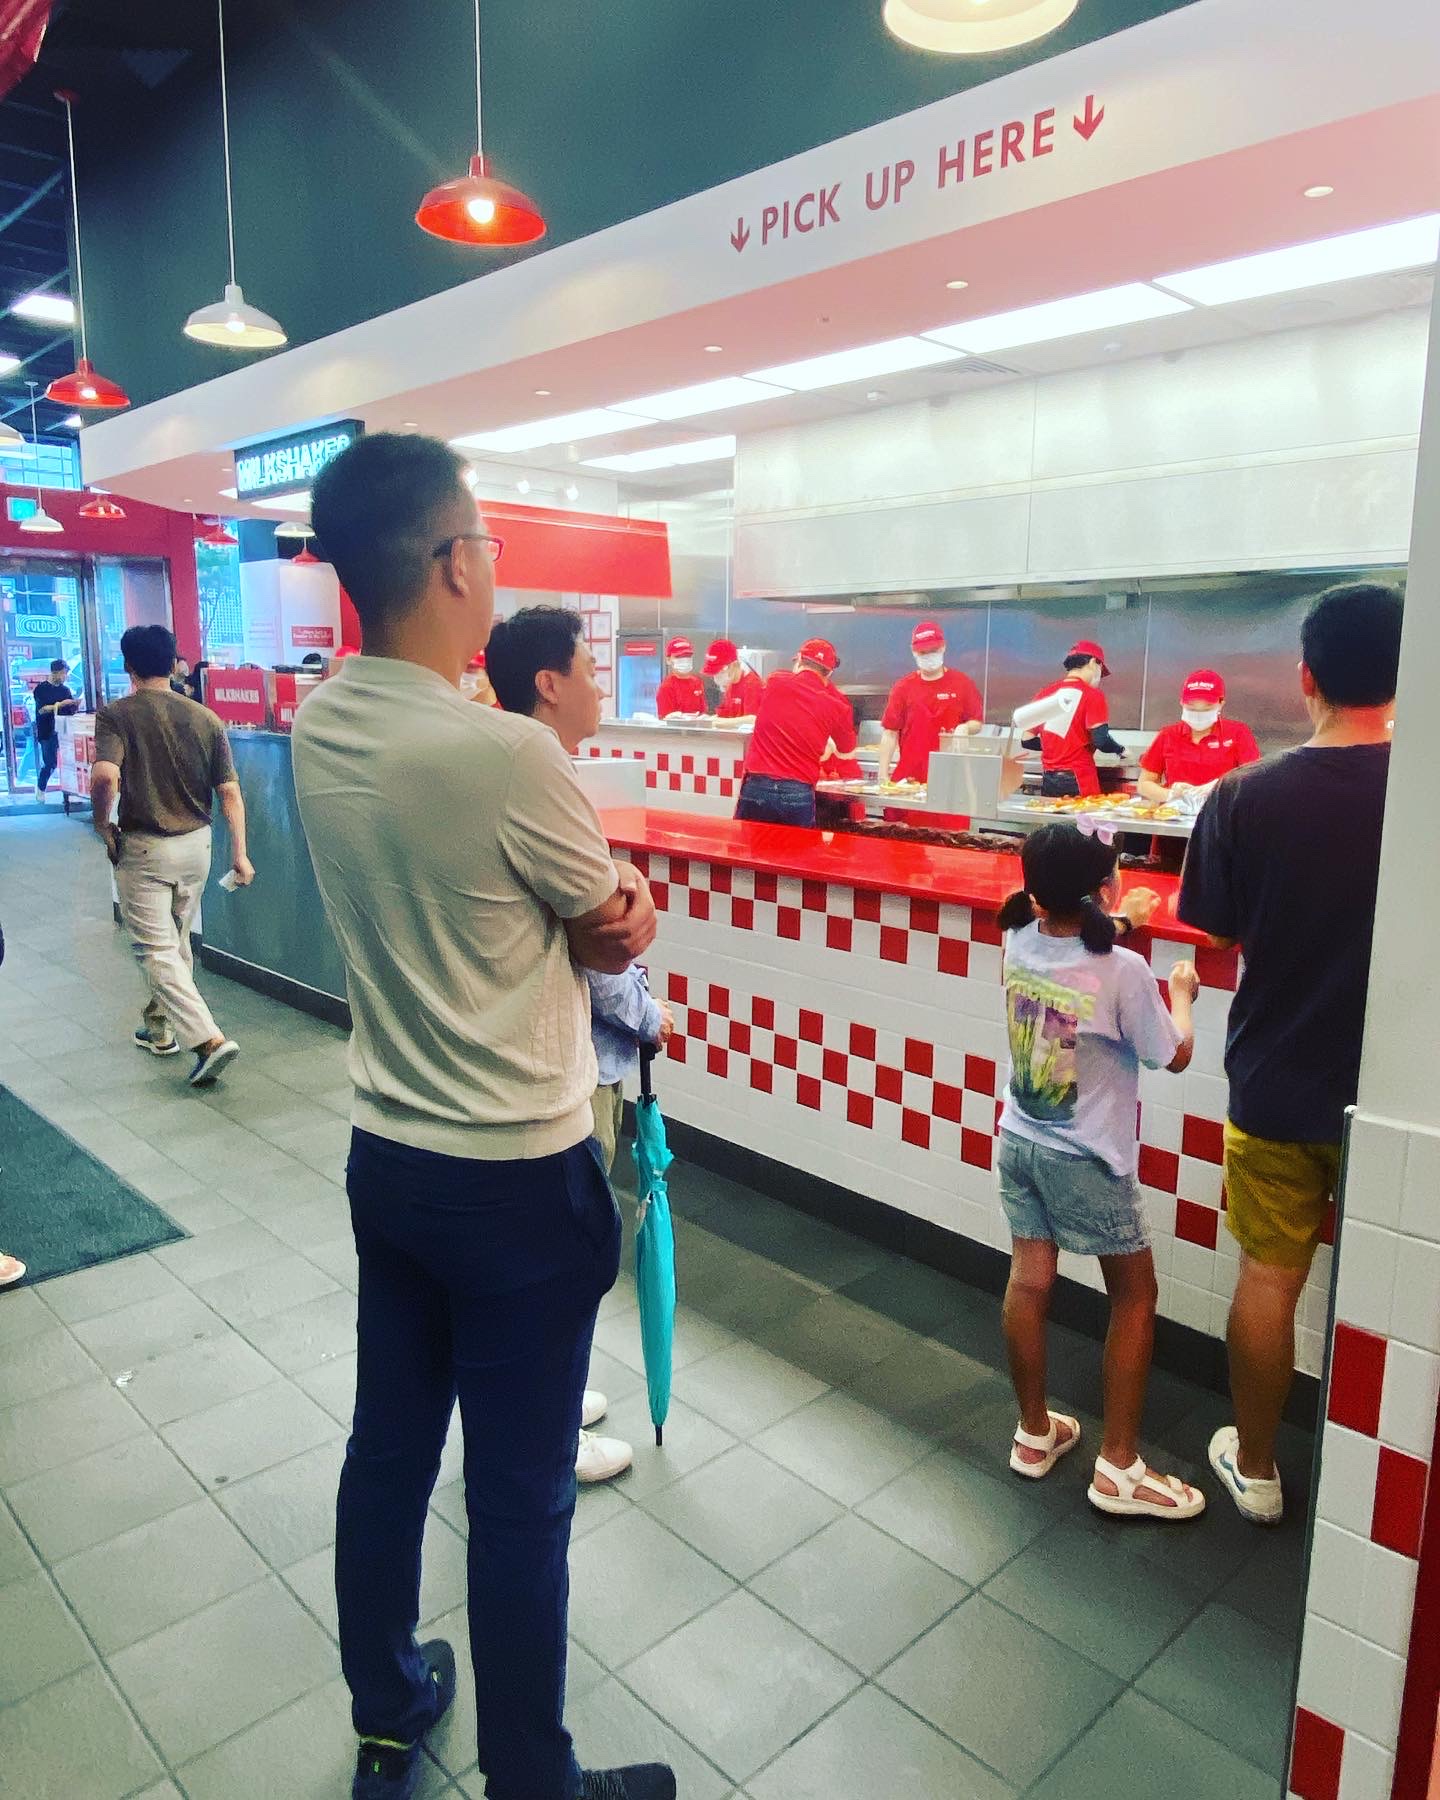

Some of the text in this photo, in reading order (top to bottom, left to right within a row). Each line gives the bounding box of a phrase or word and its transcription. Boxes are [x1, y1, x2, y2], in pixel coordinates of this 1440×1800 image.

[762, 107, 1056, 246] PICK UP HERE
